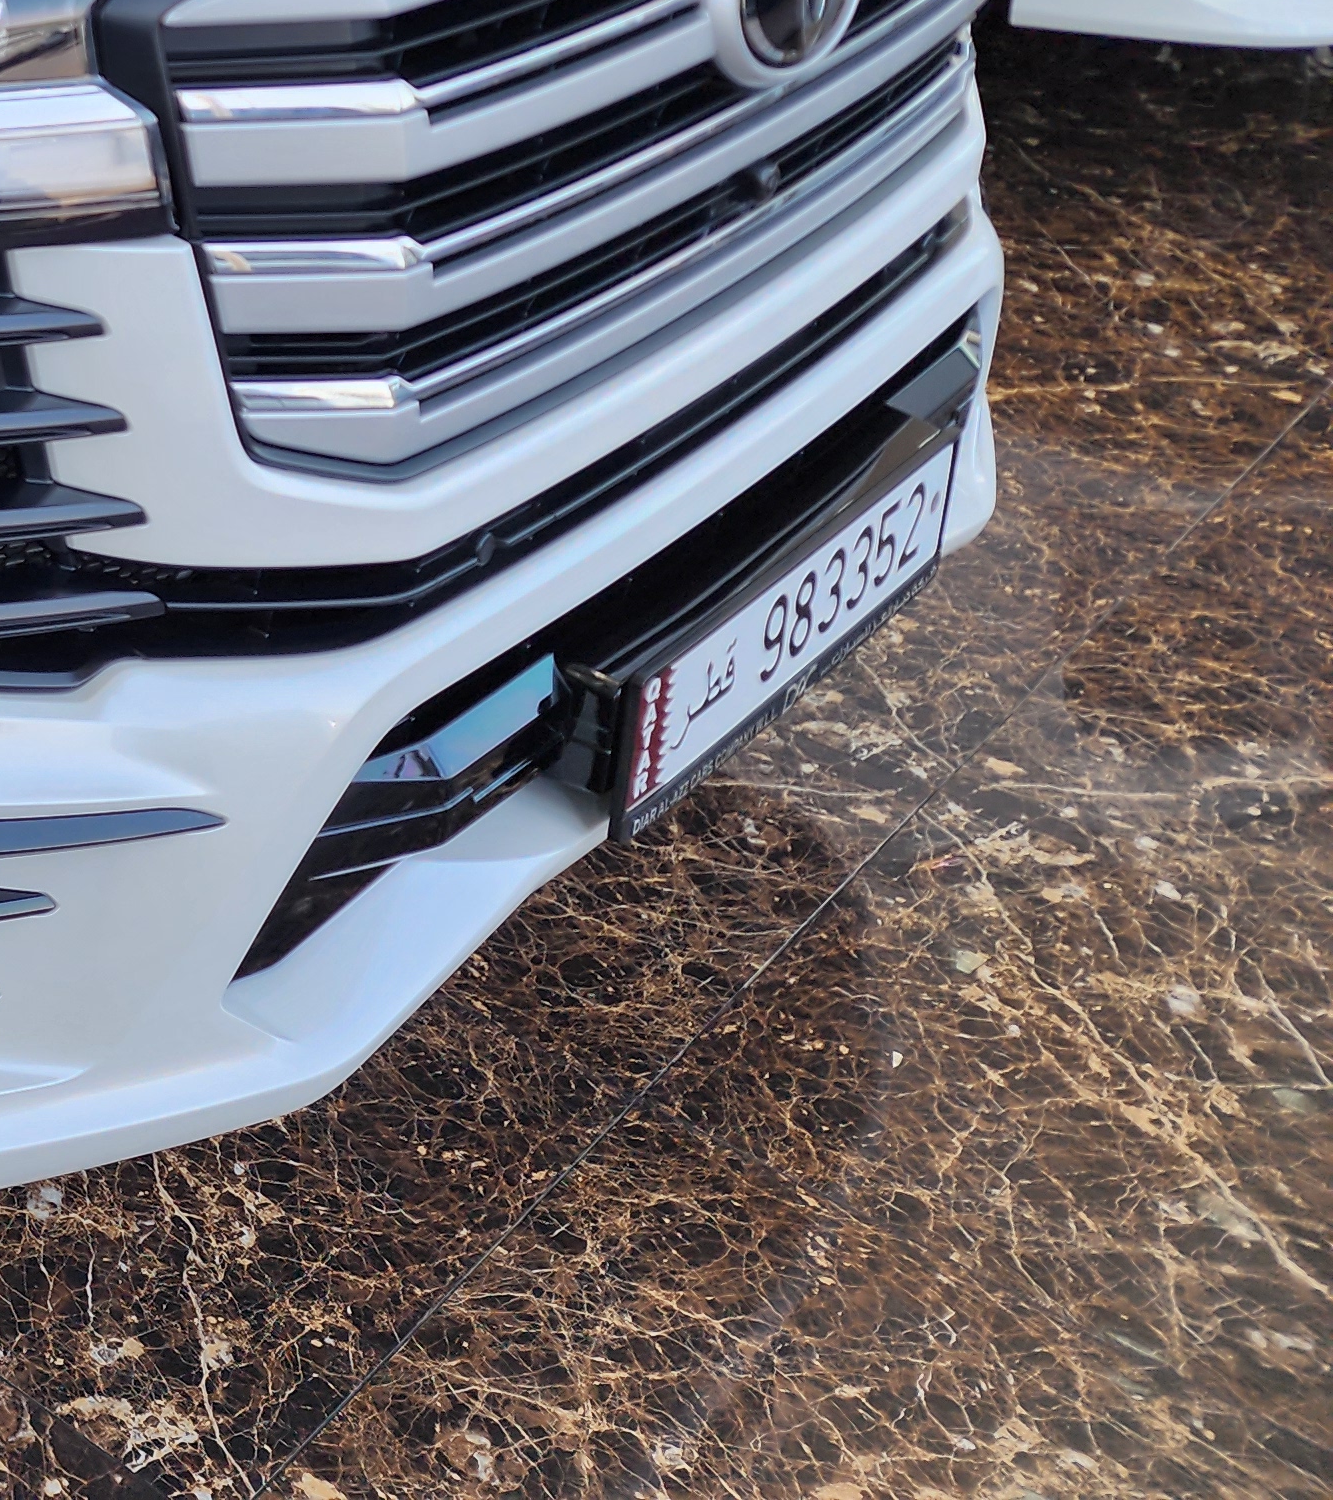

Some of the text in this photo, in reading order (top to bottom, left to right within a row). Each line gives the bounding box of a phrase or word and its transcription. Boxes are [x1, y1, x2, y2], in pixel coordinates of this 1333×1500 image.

[760, 481, 927, 684] 983352
[632, 675, 663, 801] QATAR
[670, 638, 739, 751] قطر
